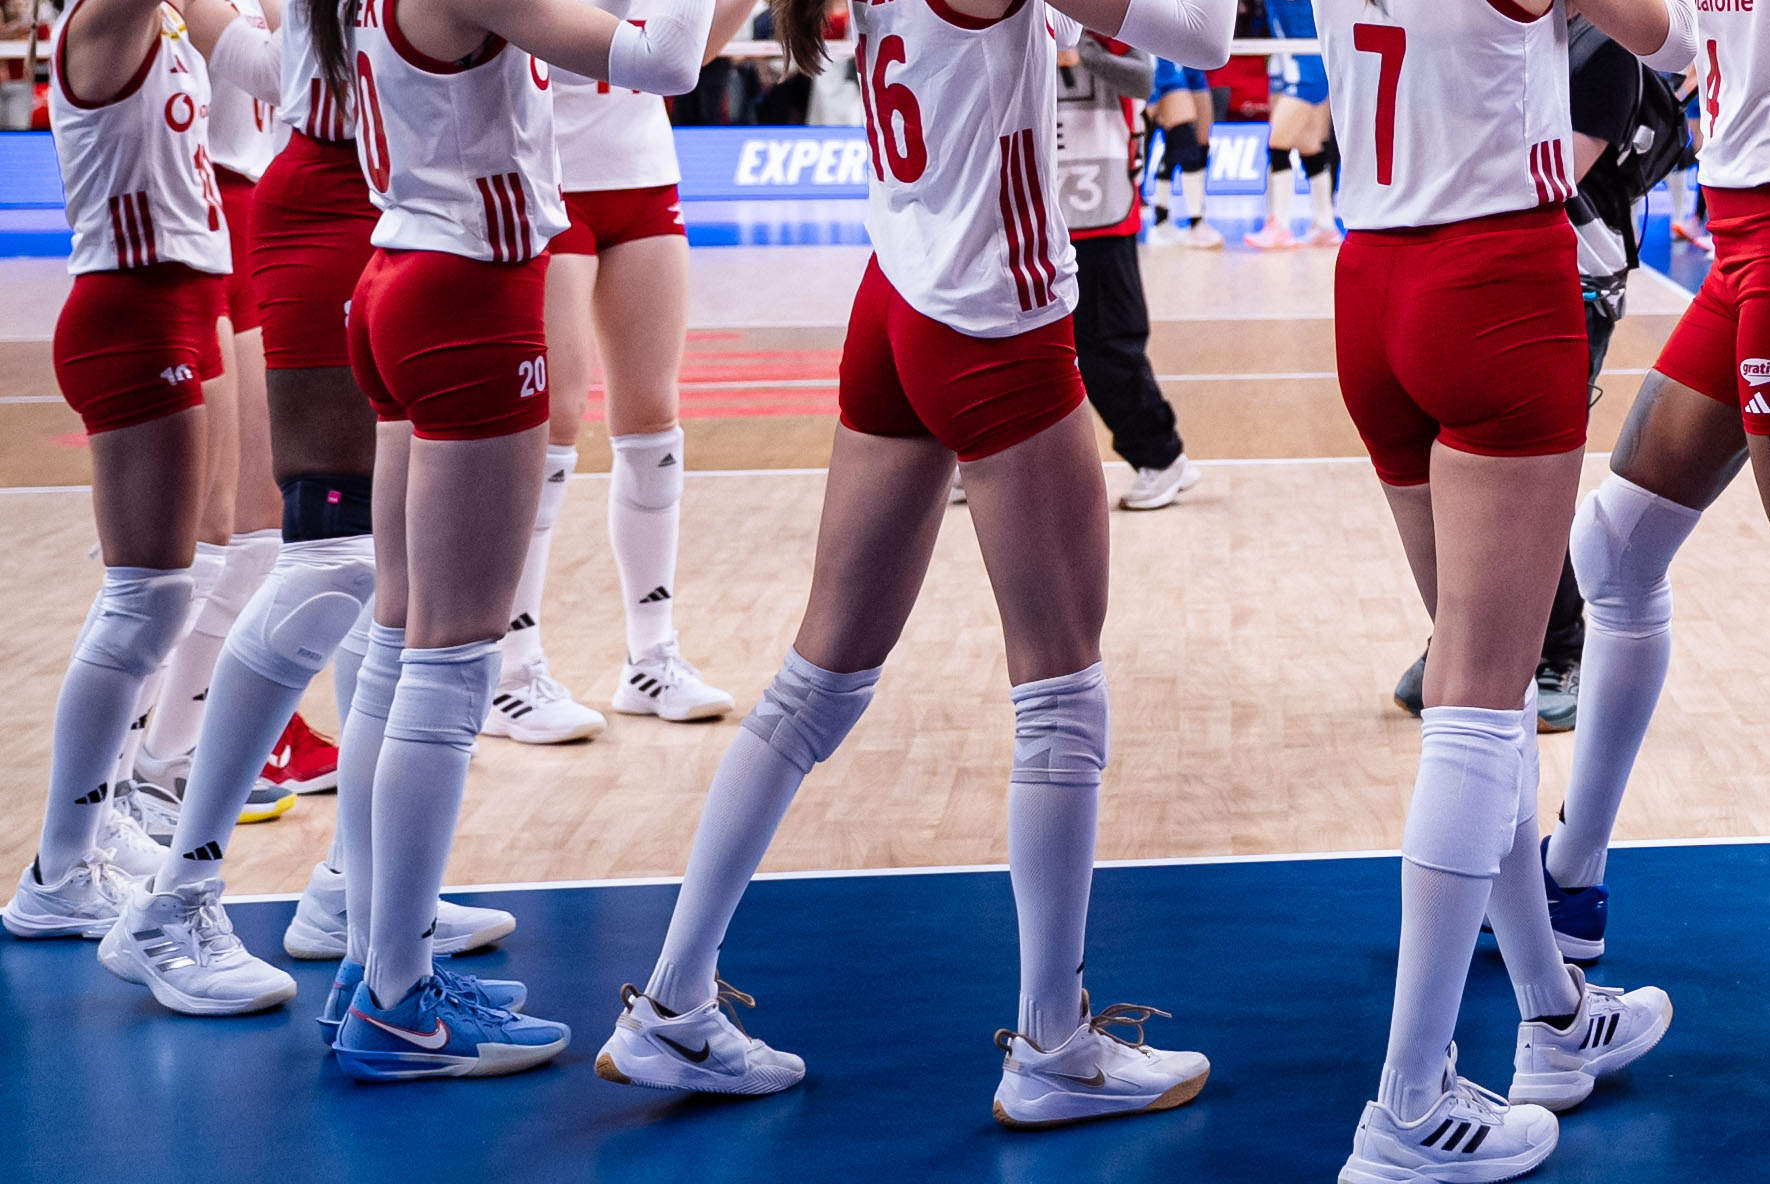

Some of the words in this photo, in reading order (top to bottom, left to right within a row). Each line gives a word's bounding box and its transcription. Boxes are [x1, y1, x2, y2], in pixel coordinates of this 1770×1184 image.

[854, 33, 928, 184] 16
[1353, 22, 1407, 186] 7
[734, 139, 868, 184] EXPER
[518, 355, 547, 399] 20
